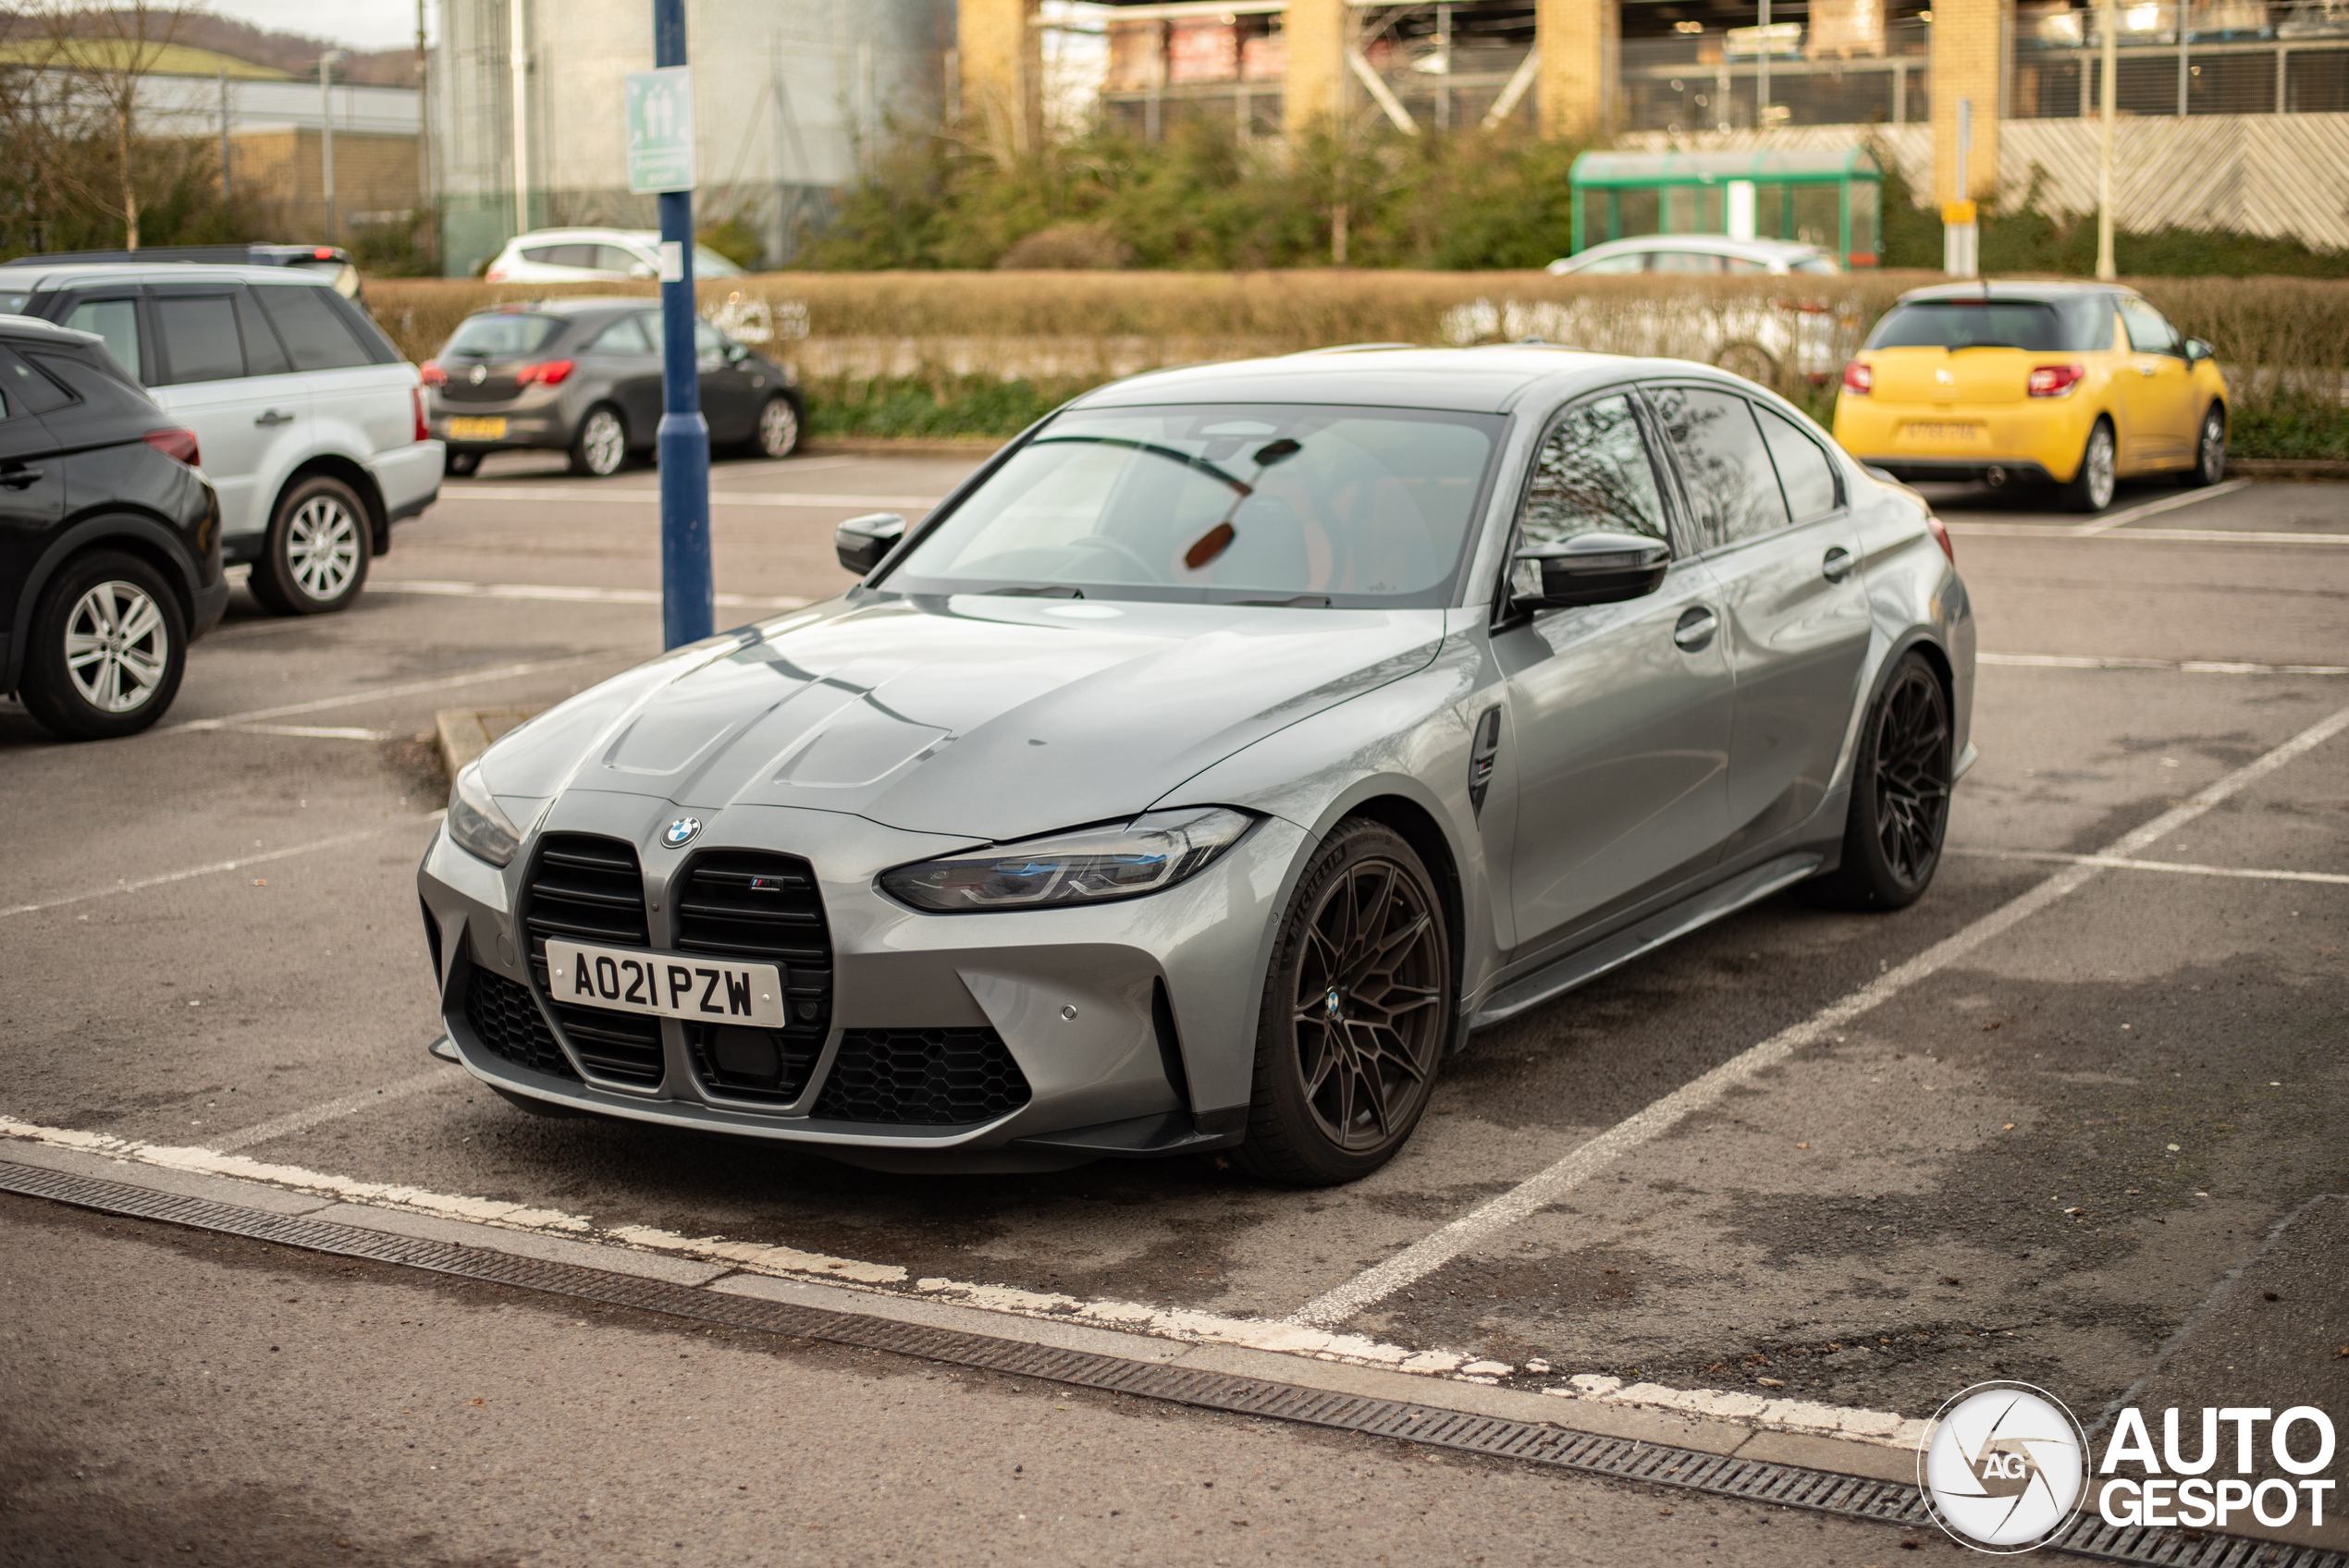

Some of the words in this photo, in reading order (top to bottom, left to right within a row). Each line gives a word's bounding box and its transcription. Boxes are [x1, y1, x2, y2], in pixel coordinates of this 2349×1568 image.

[1289, 848, 1345, 939] MICHELIN
[575, 952, 658, 1006] AO21
[667, 964, 752, 1016] PZW
